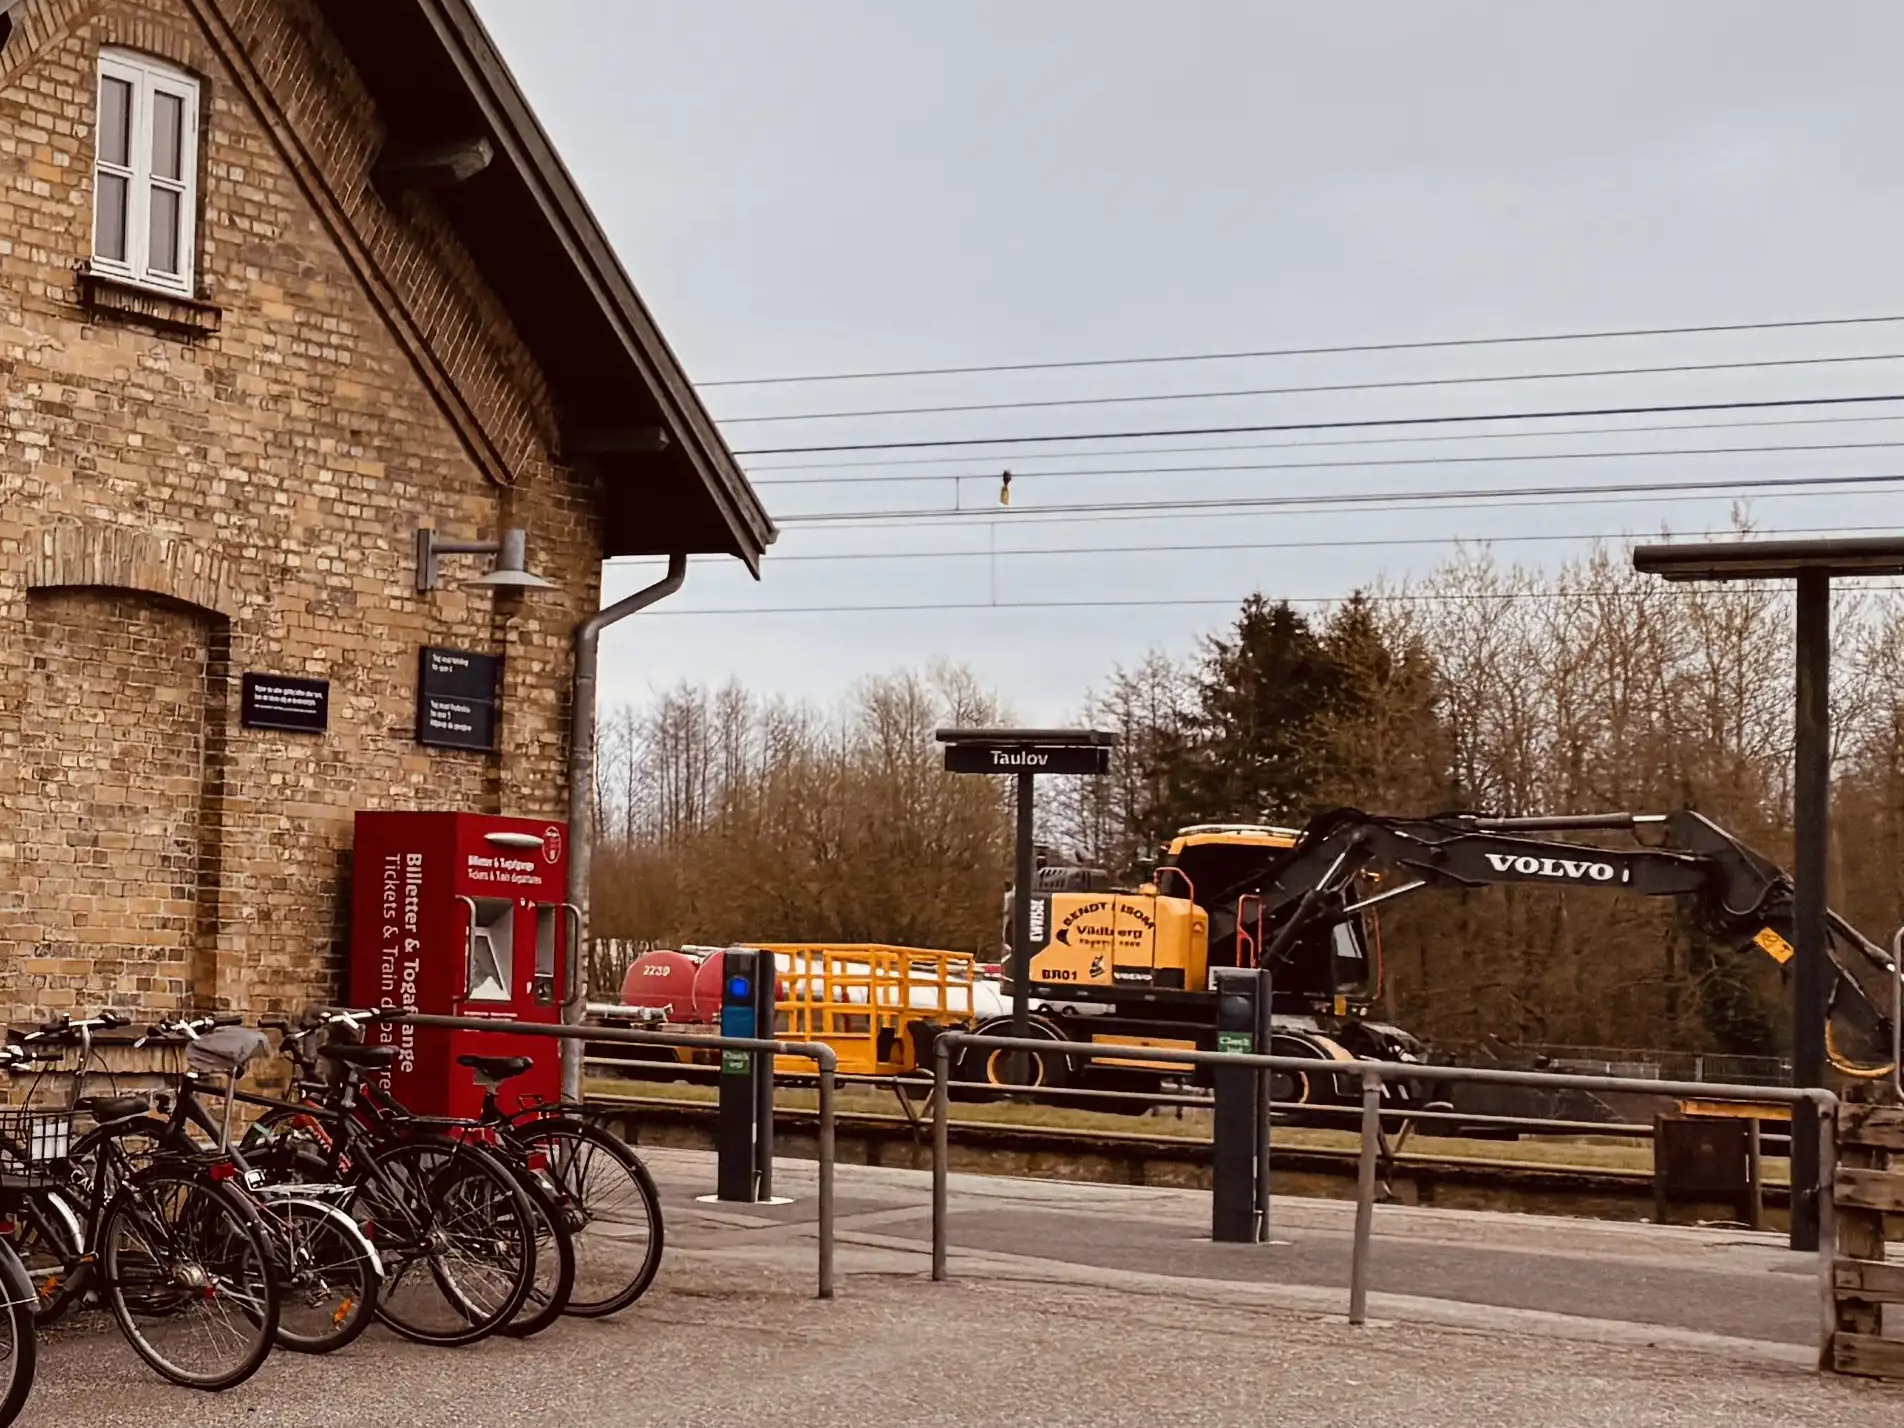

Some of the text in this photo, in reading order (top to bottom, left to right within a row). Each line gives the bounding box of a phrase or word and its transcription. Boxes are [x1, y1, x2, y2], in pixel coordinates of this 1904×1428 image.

[990, 750, 1049, 765] Taulov
[1484, 853, 1615, 881] VOLVO
[383, 853, 401, 919] Tickets
[1063, 902, 1108, 927] BENDT
[382, 925, 399, 939] &
[381, 945, 399, 991] Train
[398, 853, 423, 1072] Billetter & Togafange
[1042, 969, 1077, 980] BR01
